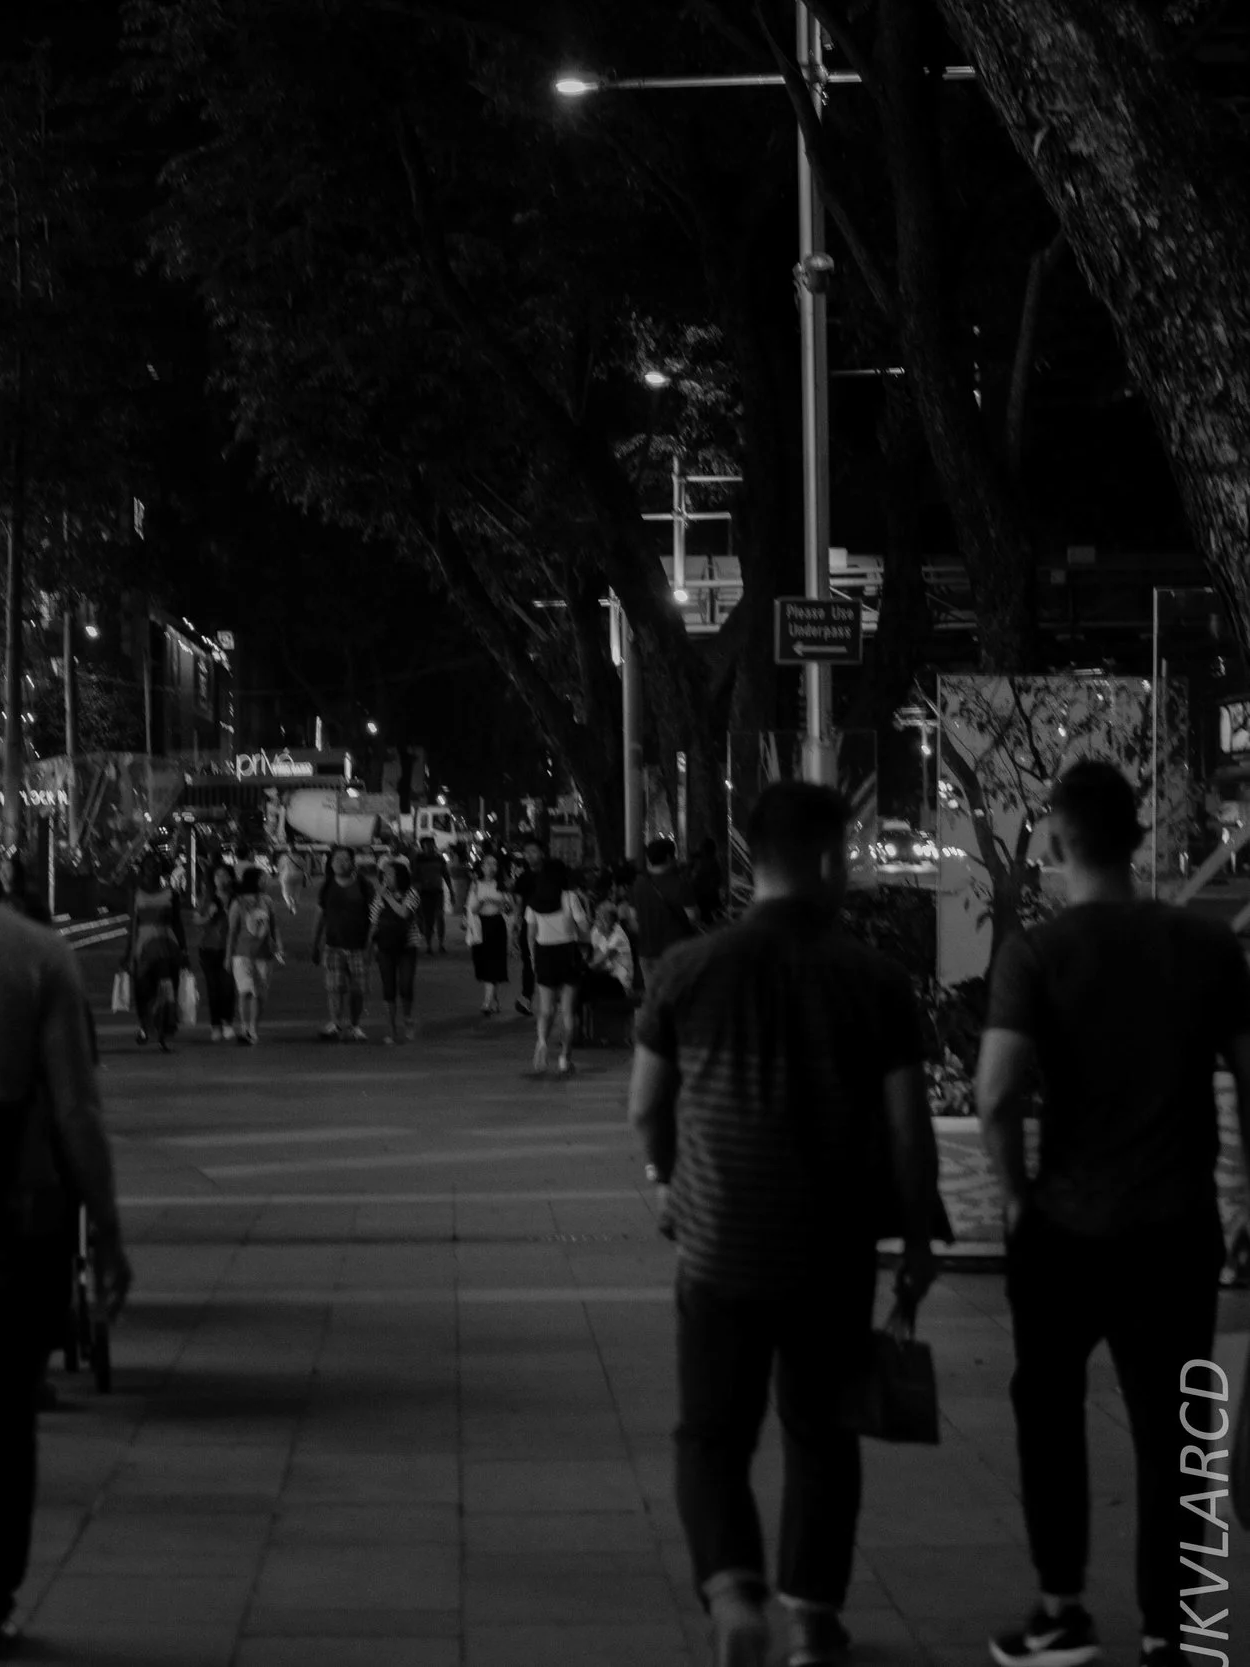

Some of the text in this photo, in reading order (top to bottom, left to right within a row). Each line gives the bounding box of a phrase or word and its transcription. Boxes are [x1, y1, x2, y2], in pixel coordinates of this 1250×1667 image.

[785, 603, 855, 621] Please Use
[788, 621, 852, 641] Underpass
